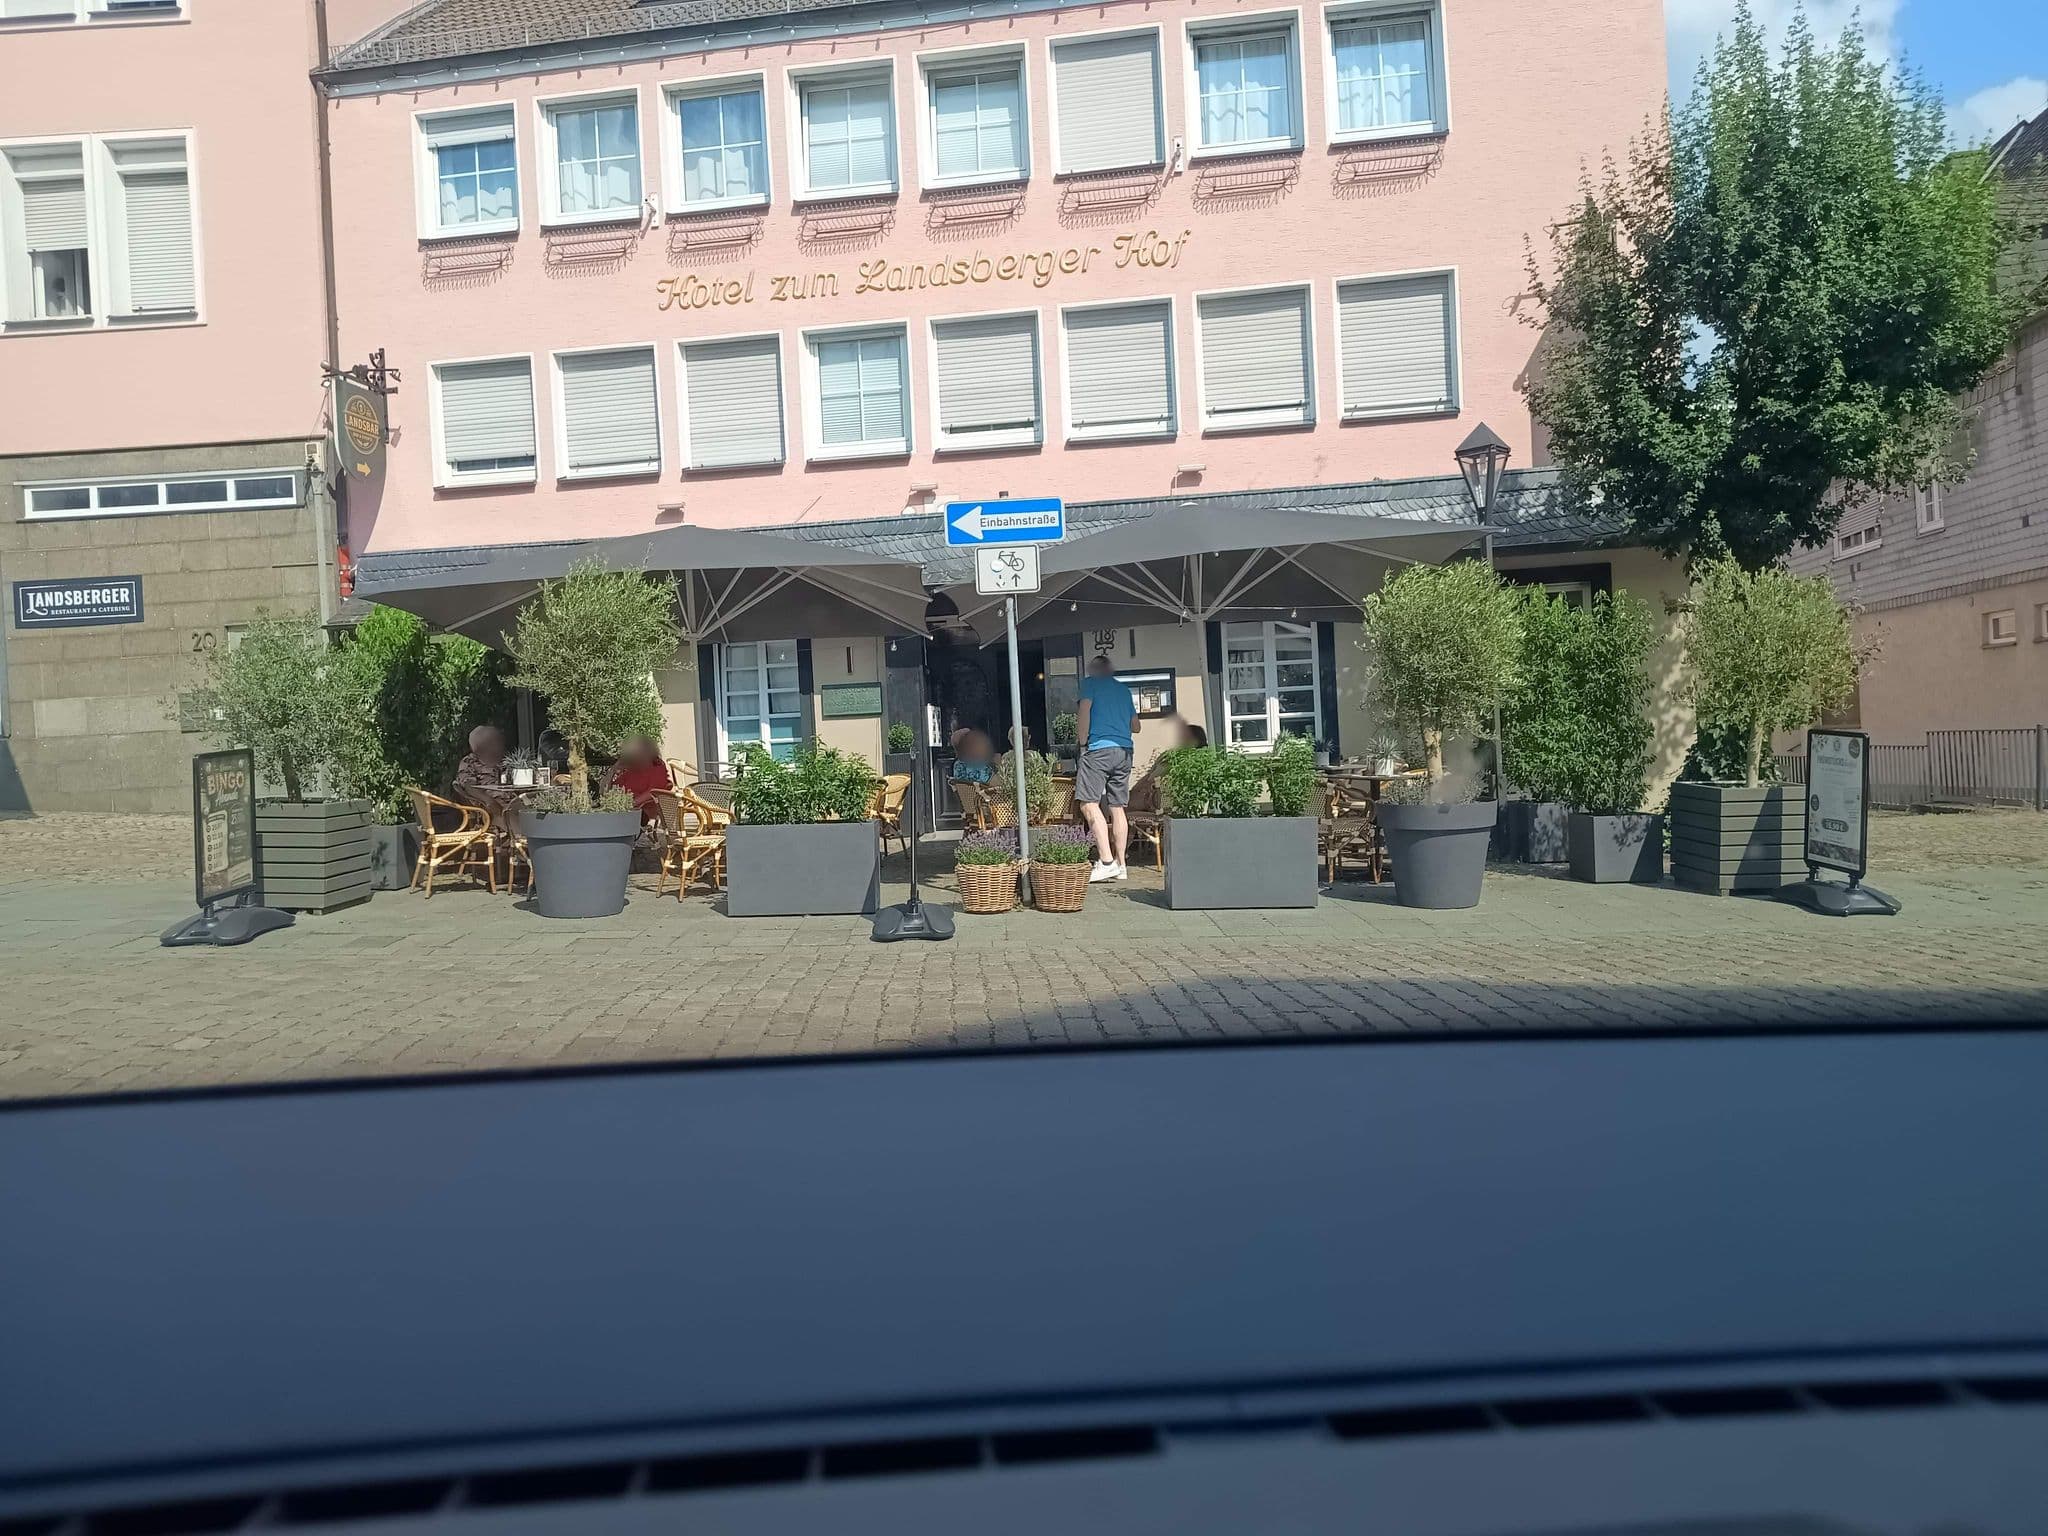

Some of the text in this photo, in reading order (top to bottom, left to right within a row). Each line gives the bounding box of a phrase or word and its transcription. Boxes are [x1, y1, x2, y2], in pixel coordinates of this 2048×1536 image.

[657, 229, 1192, 311] Hotel zum Landsberger Hof
[345, 414, 380, 435] LANDSBAR
[980, 514, 1056, 528] Einbahnstraße
[26, 587, 130, 616] LANDSBERGER
[51, 607, 91, 615] RESTAURANT
[98, 605, 131, 613] CATERING
[192, 632, 217, 652] 20
[207, 771, 244, 796] BINGO
